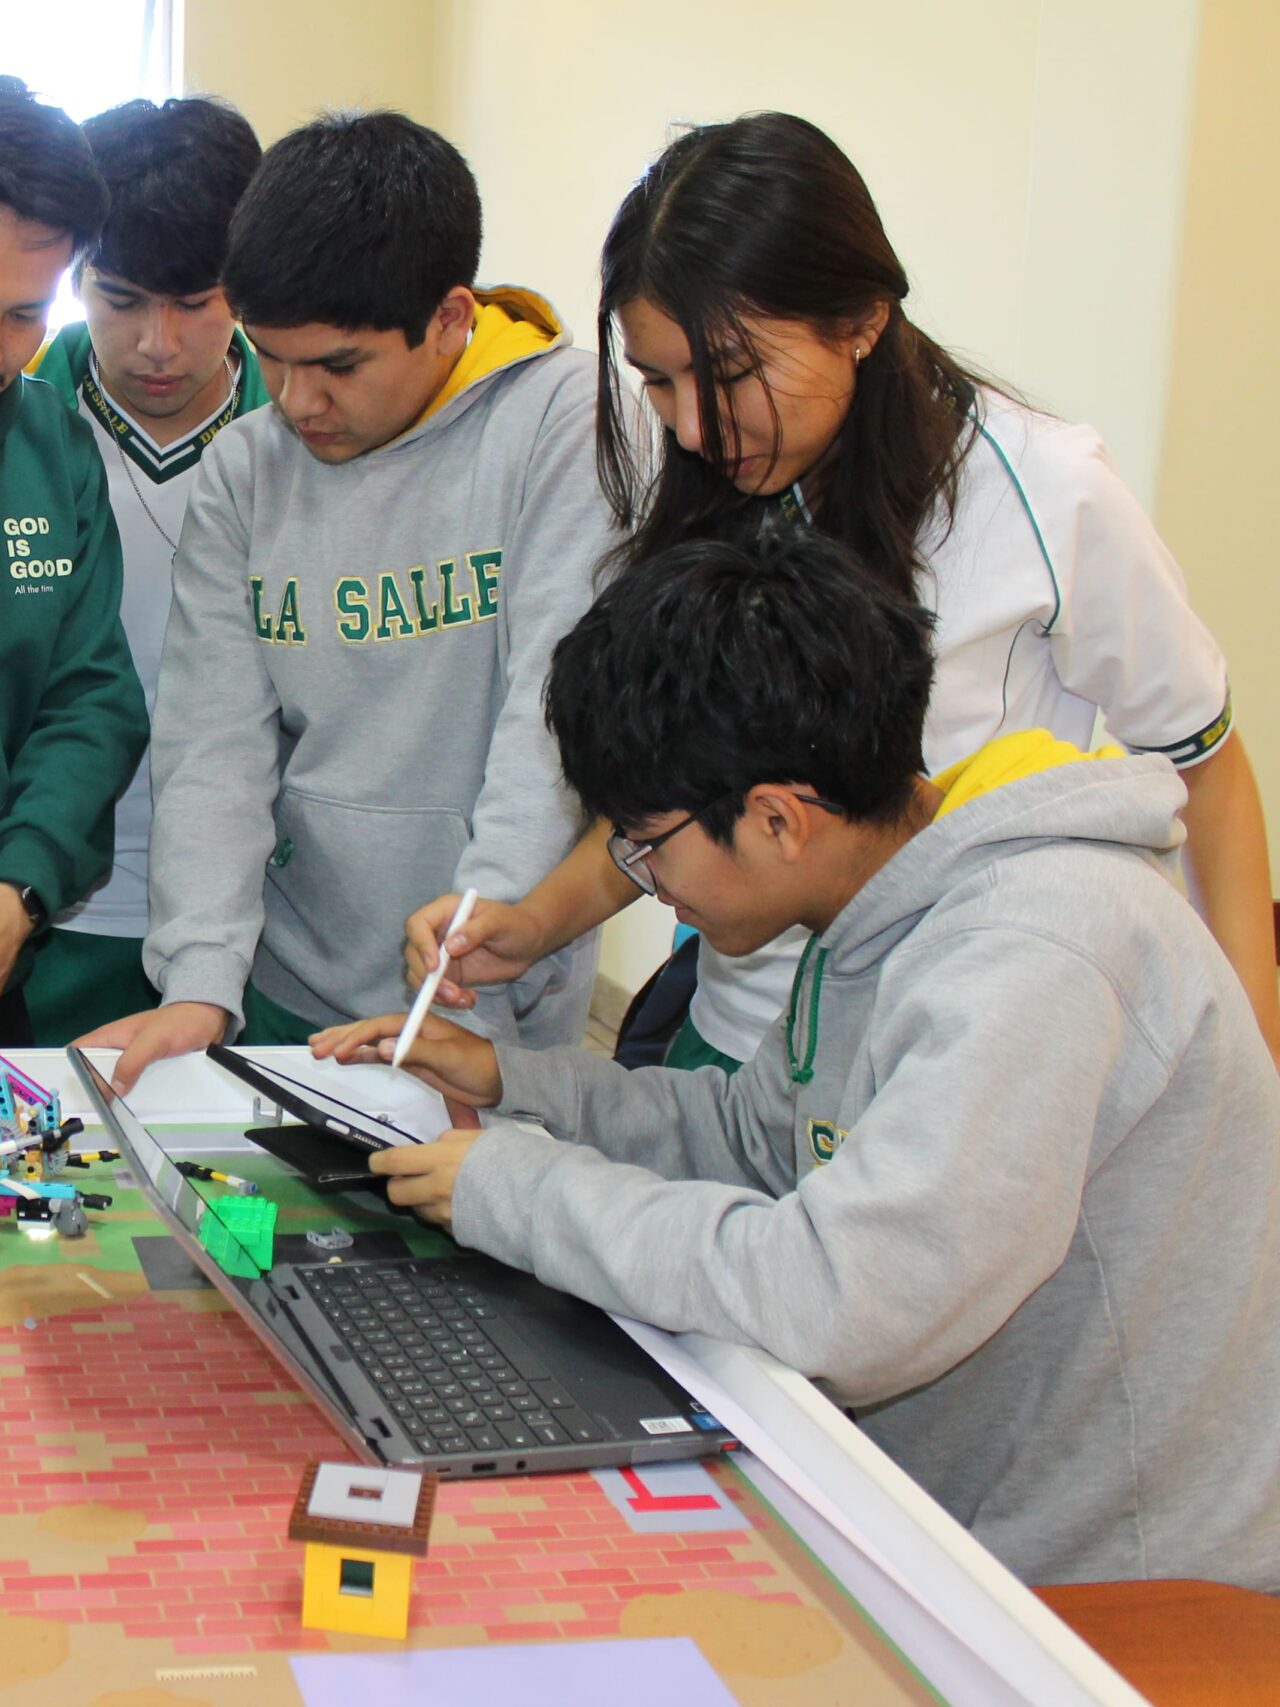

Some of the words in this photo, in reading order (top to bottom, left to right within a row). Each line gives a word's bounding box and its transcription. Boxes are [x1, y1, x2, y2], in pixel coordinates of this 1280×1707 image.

[3, 517, 50, 536] GOD
[7, 538, 31, 558] IS
[10, 558, 73, 579] GOOD
[15, 585, 26, 595] All
[27, 584, 40, 594] the
[249, 576, 308, 646] LA
[334, 547, 504, 645] SALLE
